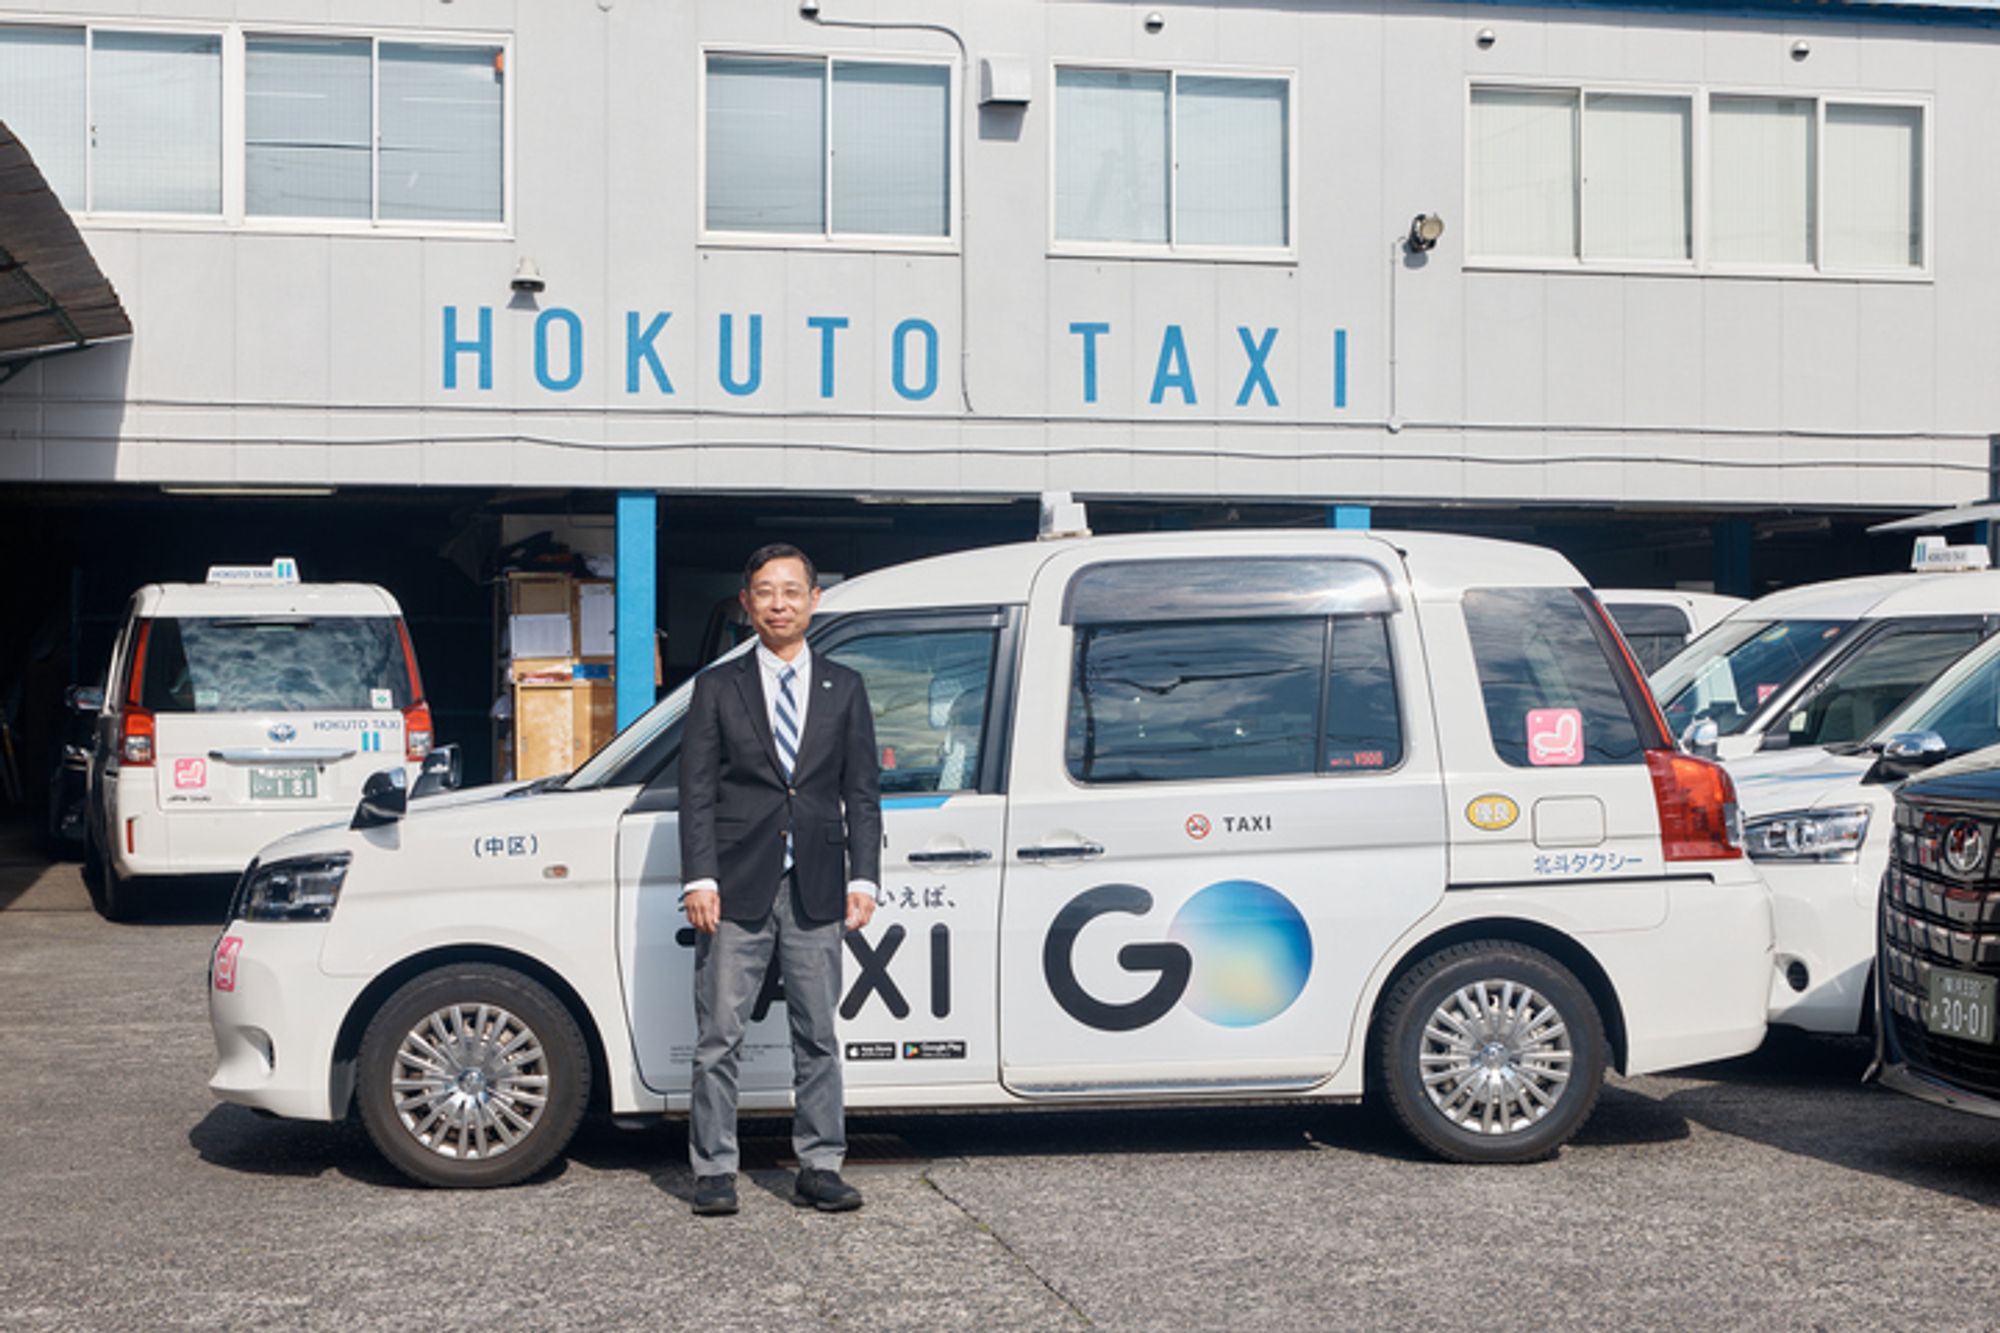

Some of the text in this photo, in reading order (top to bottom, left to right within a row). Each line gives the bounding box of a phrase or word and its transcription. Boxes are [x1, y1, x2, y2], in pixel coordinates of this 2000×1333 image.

[442, 306, 1347, 408] HOKUTO TAXI
[313, 719, 400, 730] HOKUTO TAXI
[1221, 815, 1271, 832] TAXI
[1534, 853, 1643, 873] 北斗タクシー
[675, 922, 951, 1021] XI
